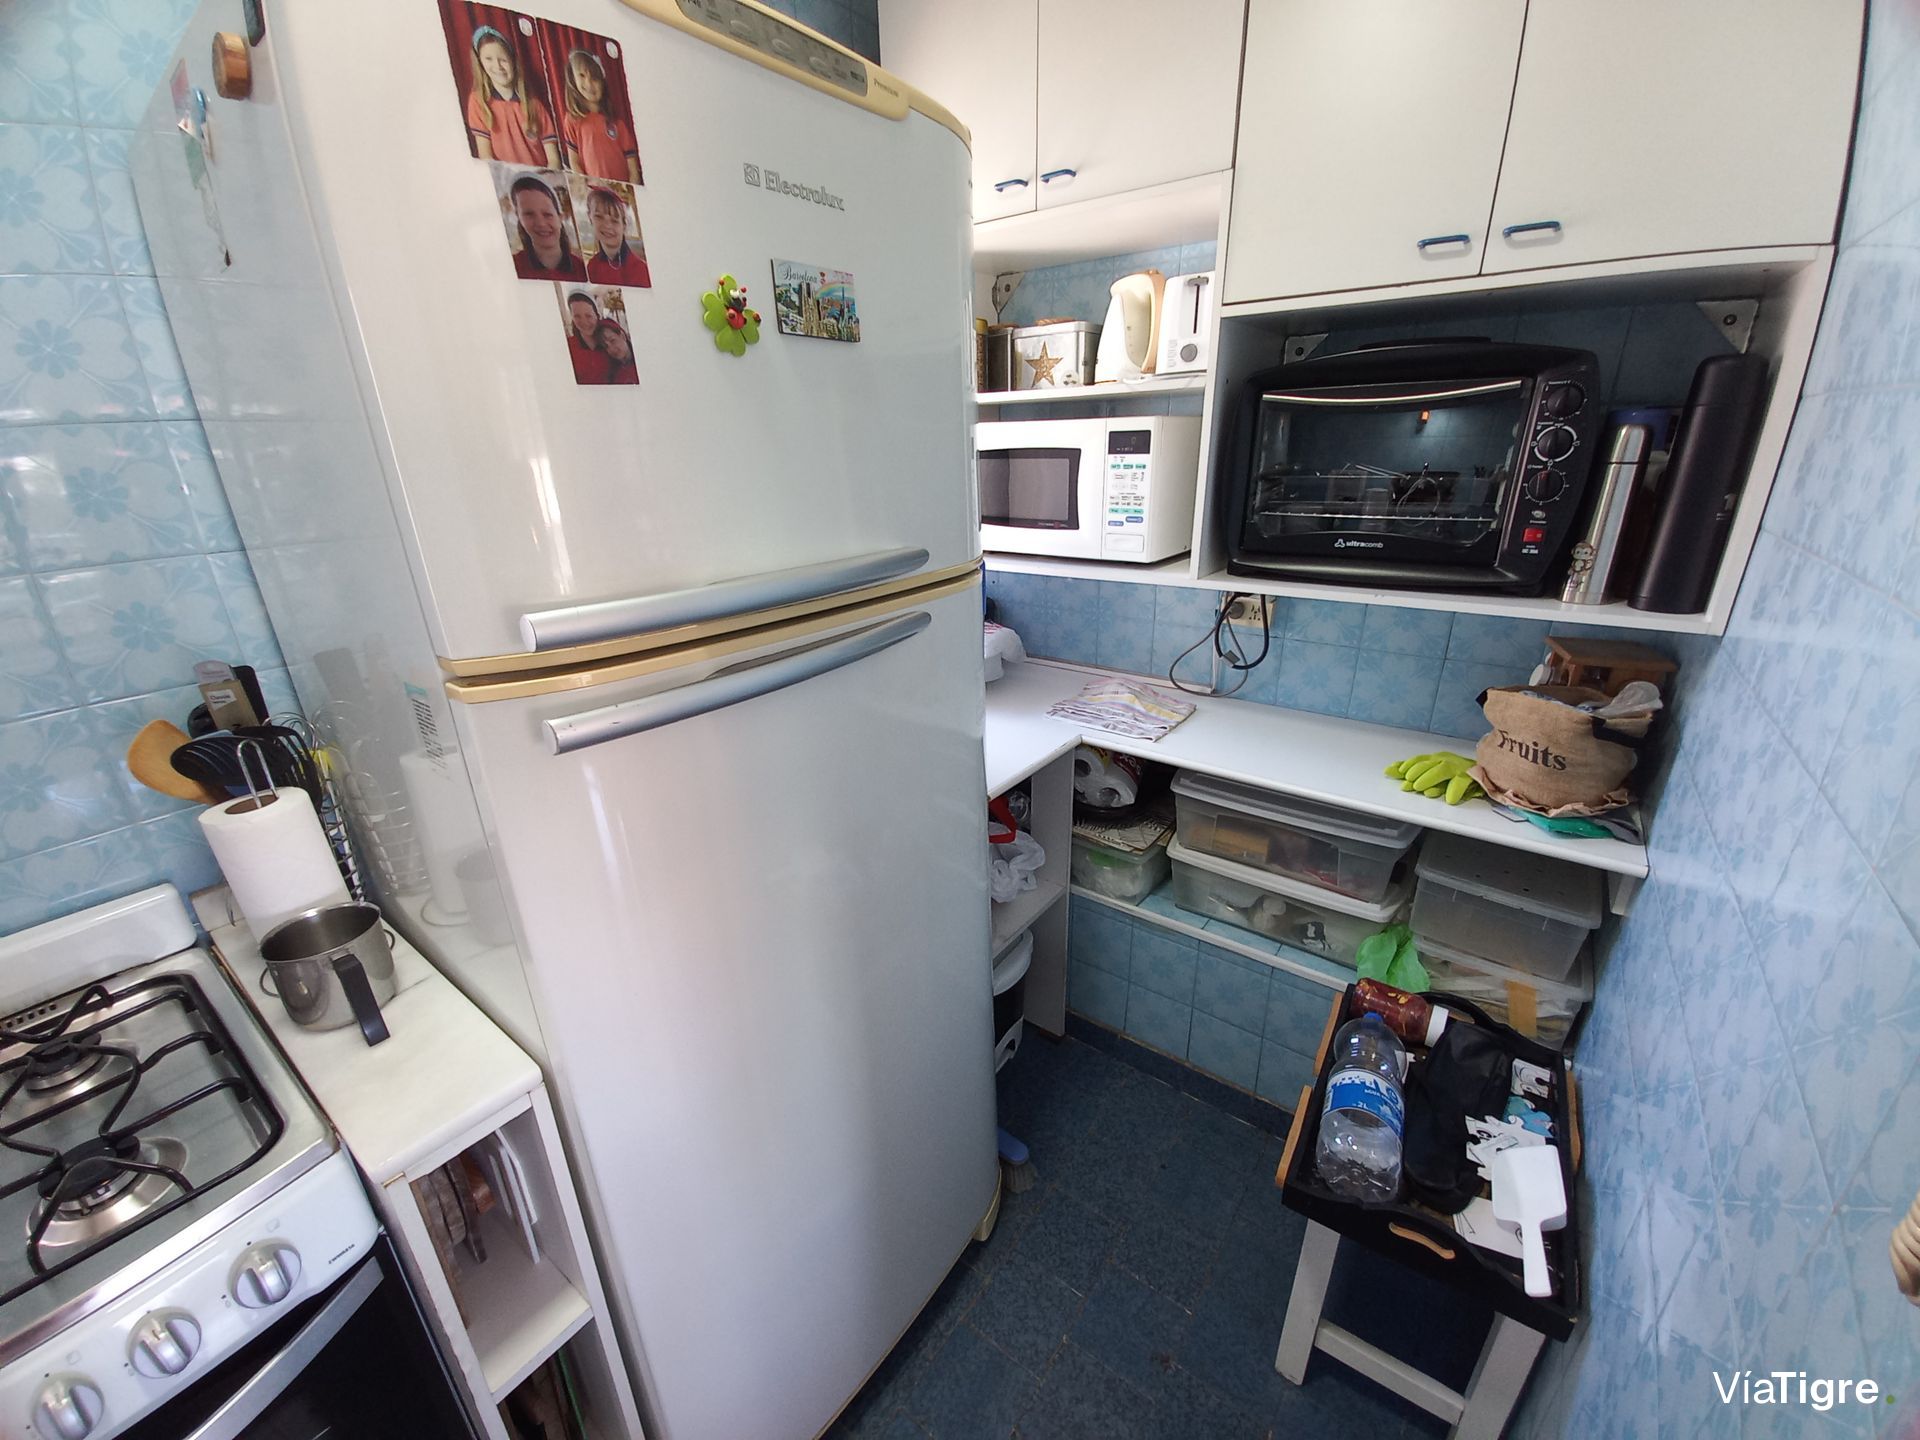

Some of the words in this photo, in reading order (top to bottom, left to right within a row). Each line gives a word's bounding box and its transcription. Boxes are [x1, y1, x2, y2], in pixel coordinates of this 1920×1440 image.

[764, 169, 845, 212] Electrolux
[1346, 540, 1384, 549] ultracomb
[1496, 729, 1568, 772] Fruits
